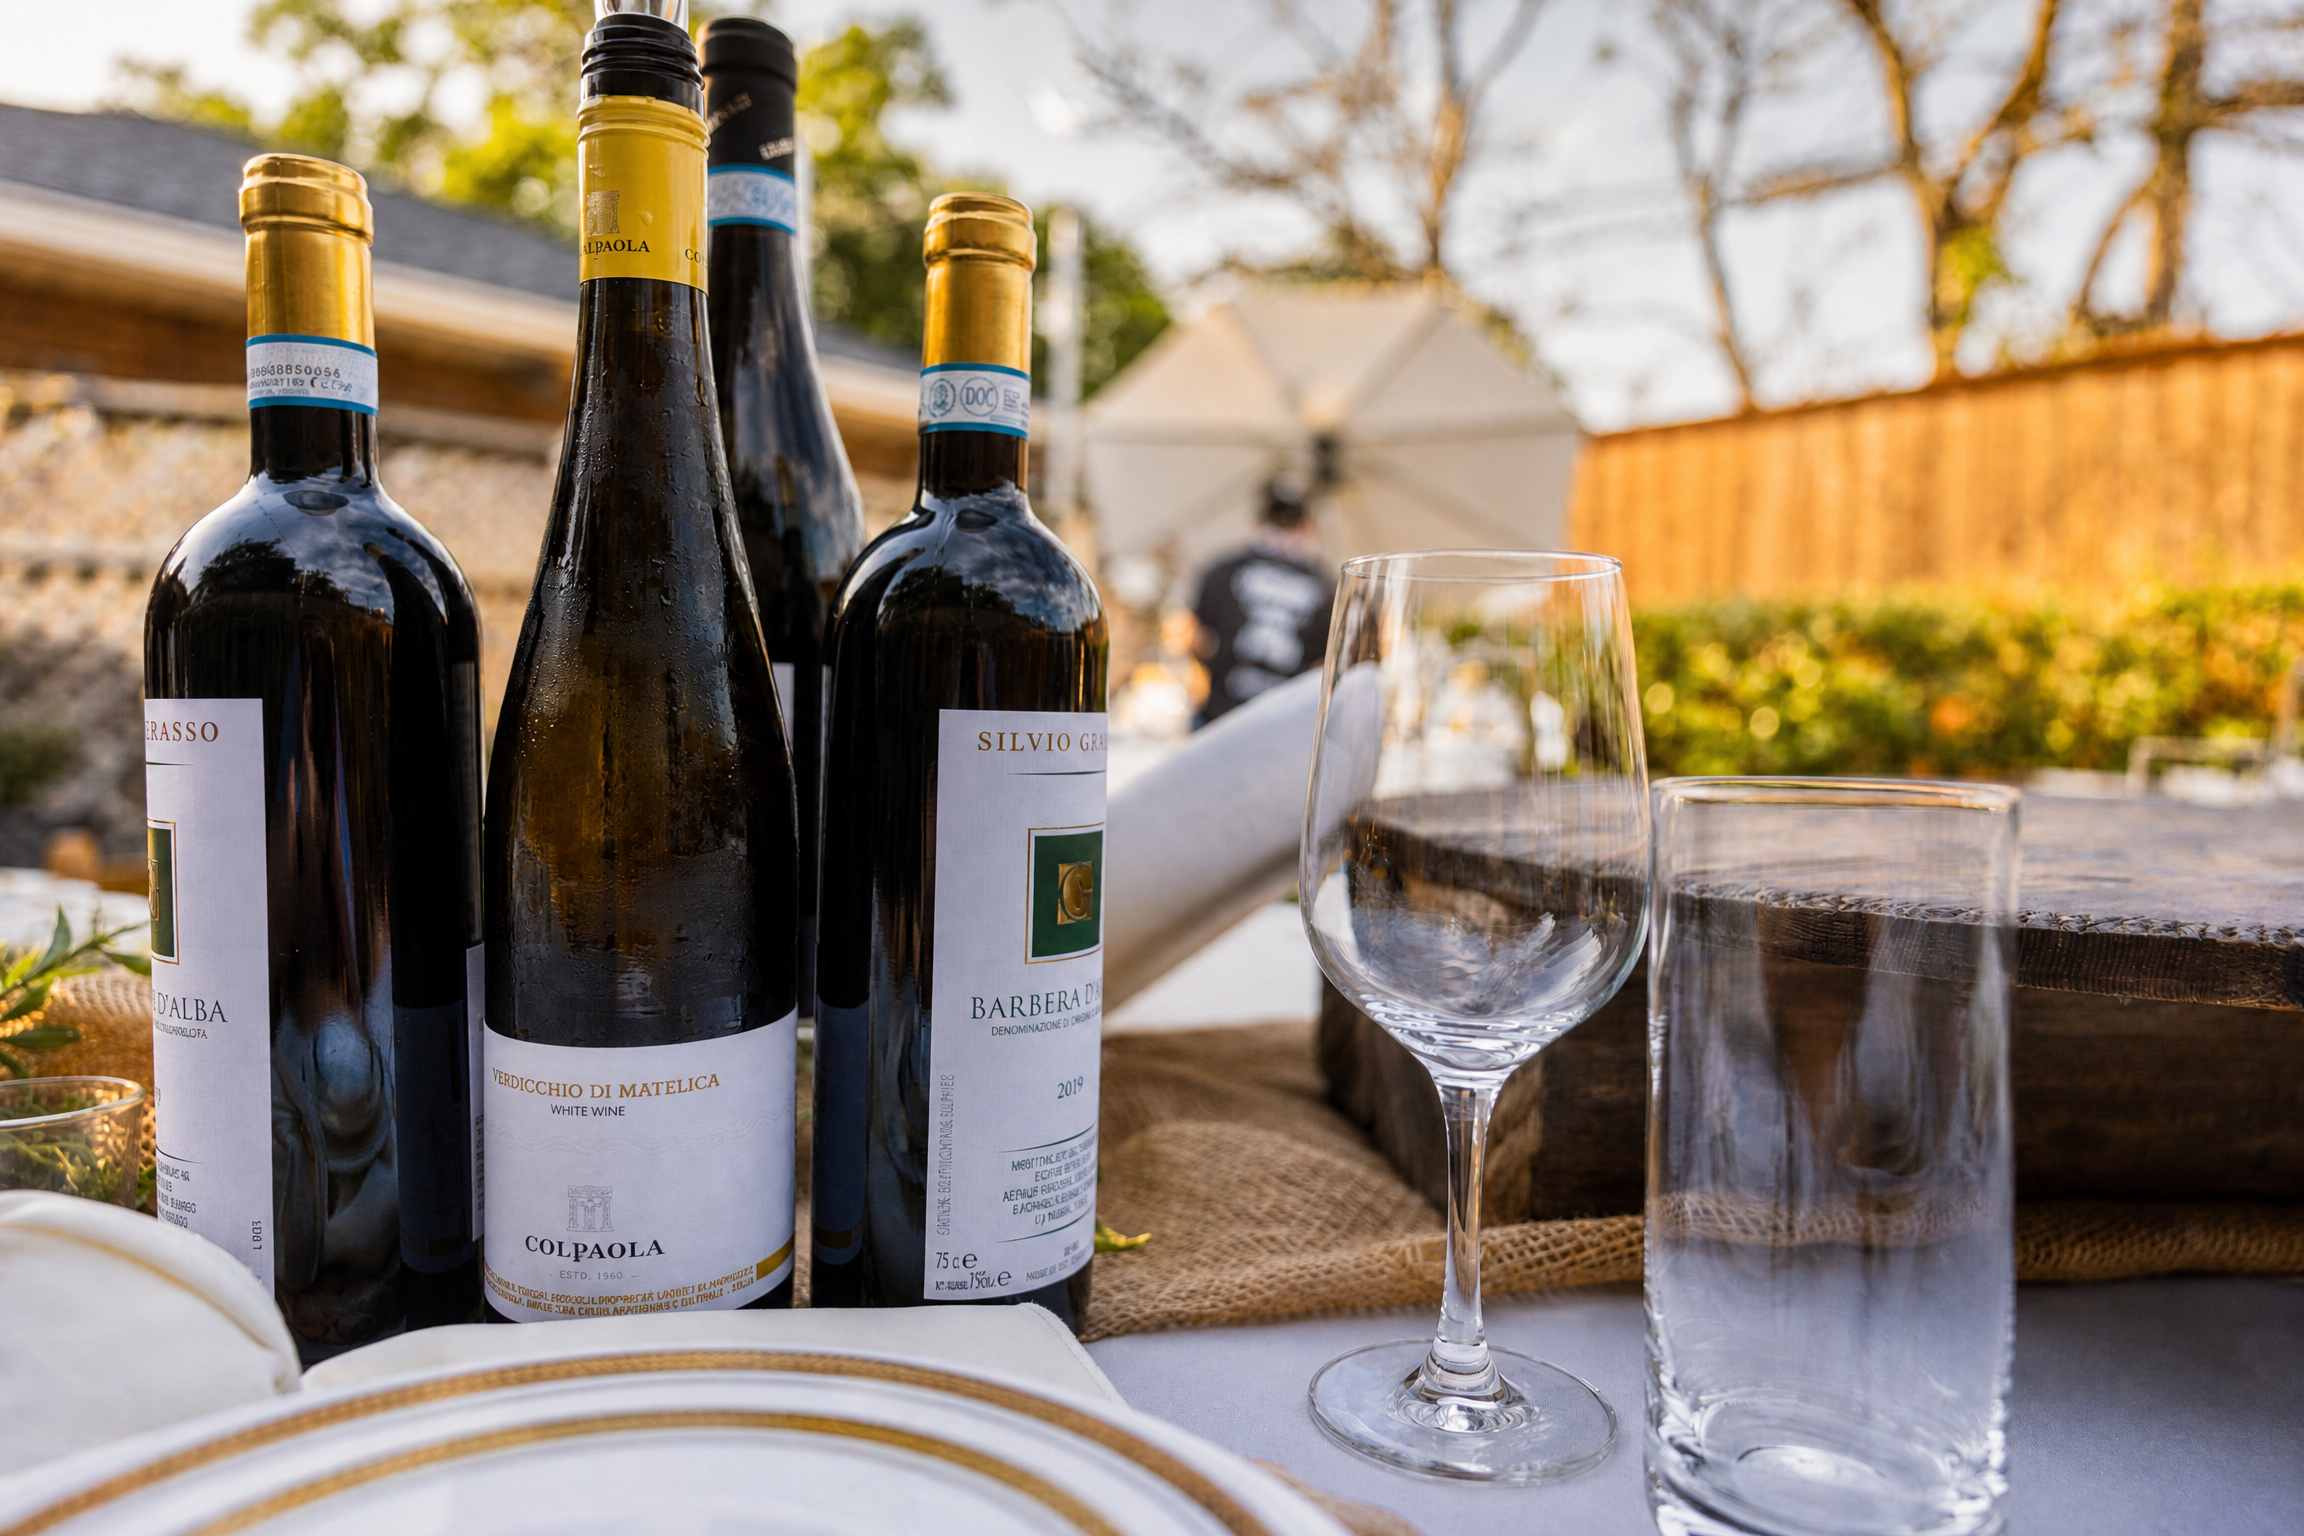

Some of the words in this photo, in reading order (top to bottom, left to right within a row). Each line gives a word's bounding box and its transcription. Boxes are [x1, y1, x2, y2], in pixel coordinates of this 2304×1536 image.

[965, 387, 994, 407] DOC
[977, 731, 1071, 752] SILVIO
[157, 992, 229, 1023] D'ALBA
[970, 988, 1081, 1020] BARBERA
[991, 1018, 1062, 1036] DENOMINAZIONE
[492, 1067, 583, 1099] VERDICCHIO
[589, 1084, 612, 1099] DI
[618, 1073, 720, 1099] MATELICA
[1057, 1075, 1084, 1099] 2019
[550, 1103, 588, 1117] WHITE
[591, 1106, 626, 1117] WINE
[524, 1235, 666, 1263] COLPAOLA
[936, 1252, 949, 1269] 75
[597, 1271, 623, 1280] 1960
